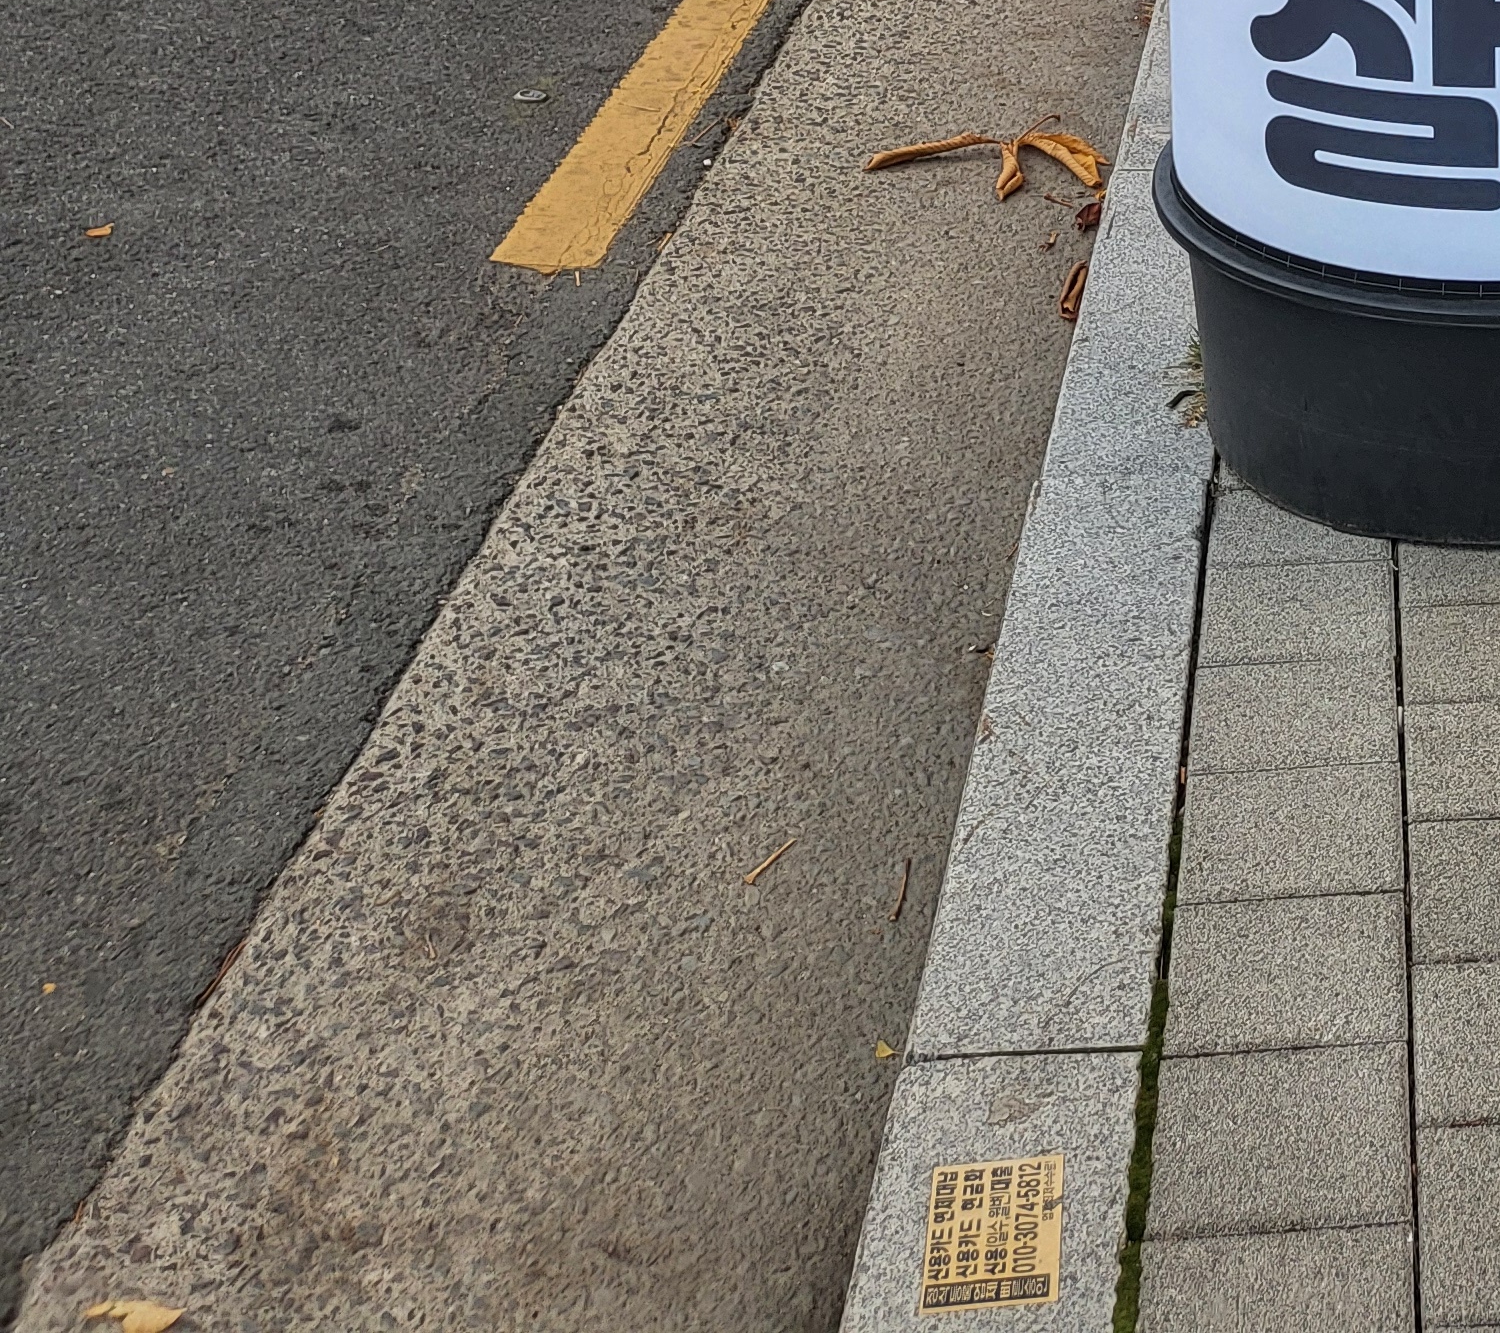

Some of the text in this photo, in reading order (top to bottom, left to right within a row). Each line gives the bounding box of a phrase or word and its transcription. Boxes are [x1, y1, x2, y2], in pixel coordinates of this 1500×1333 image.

[928, 1226, 954, 1282] 신용카드
[956, 1168, 986, 1277] 신용카드 현금화
[1012, 1162, 1042, 1274] 010-3074-5812
